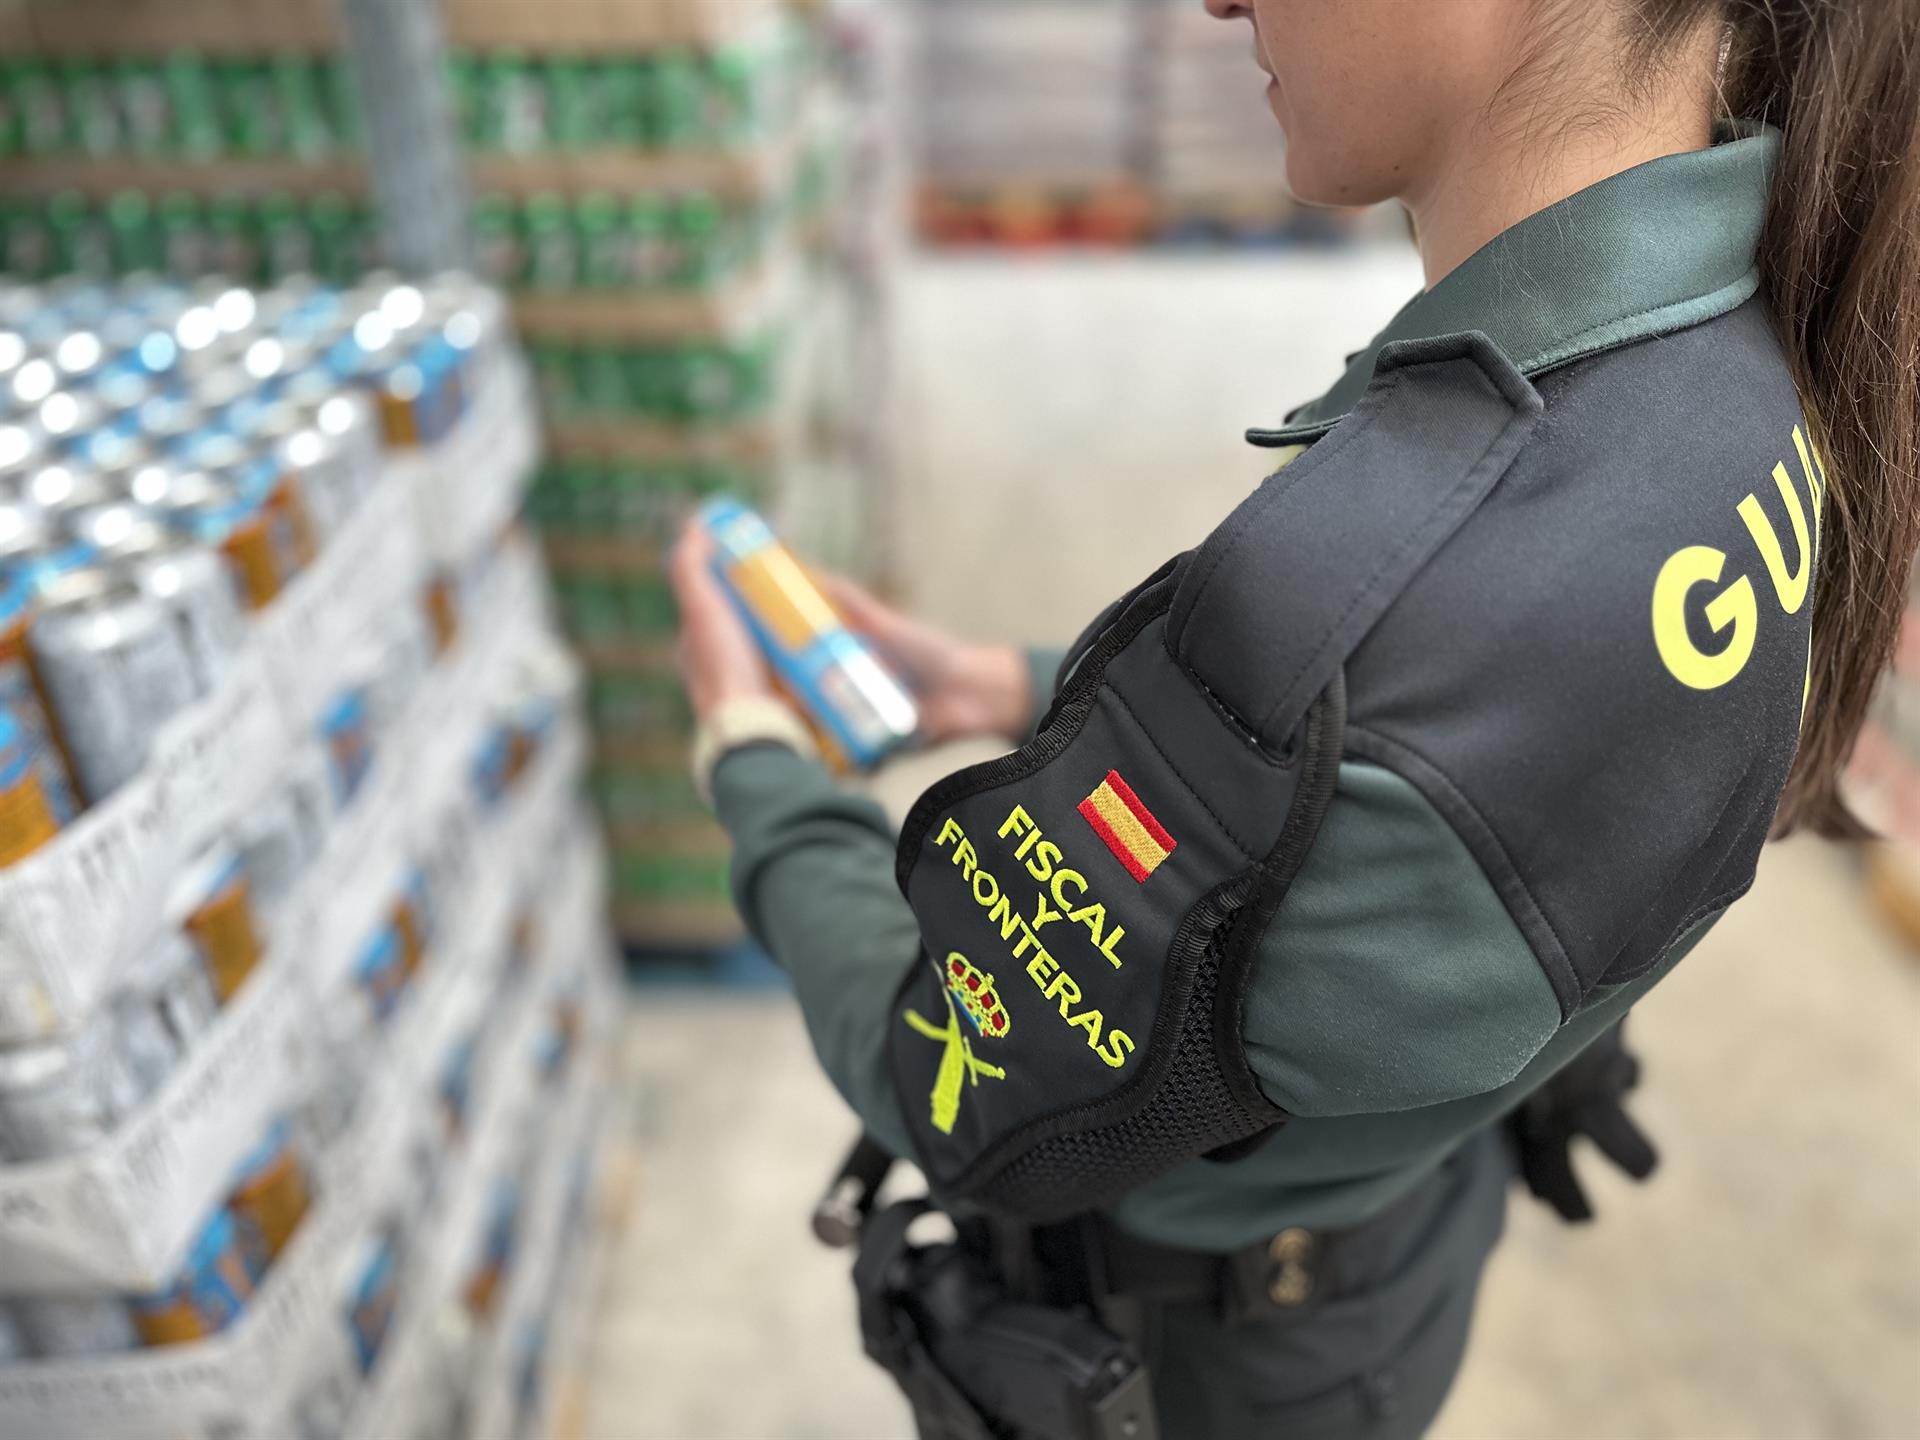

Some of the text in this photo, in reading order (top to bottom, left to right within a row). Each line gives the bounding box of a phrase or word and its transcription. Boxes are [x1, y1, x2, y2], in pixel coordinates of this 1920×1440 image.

[935, 818, 1135, 1068] FRONTERAS
[997, 804, 1125, 969] FISCAL
[1032, 892, 1063, 931] Y
